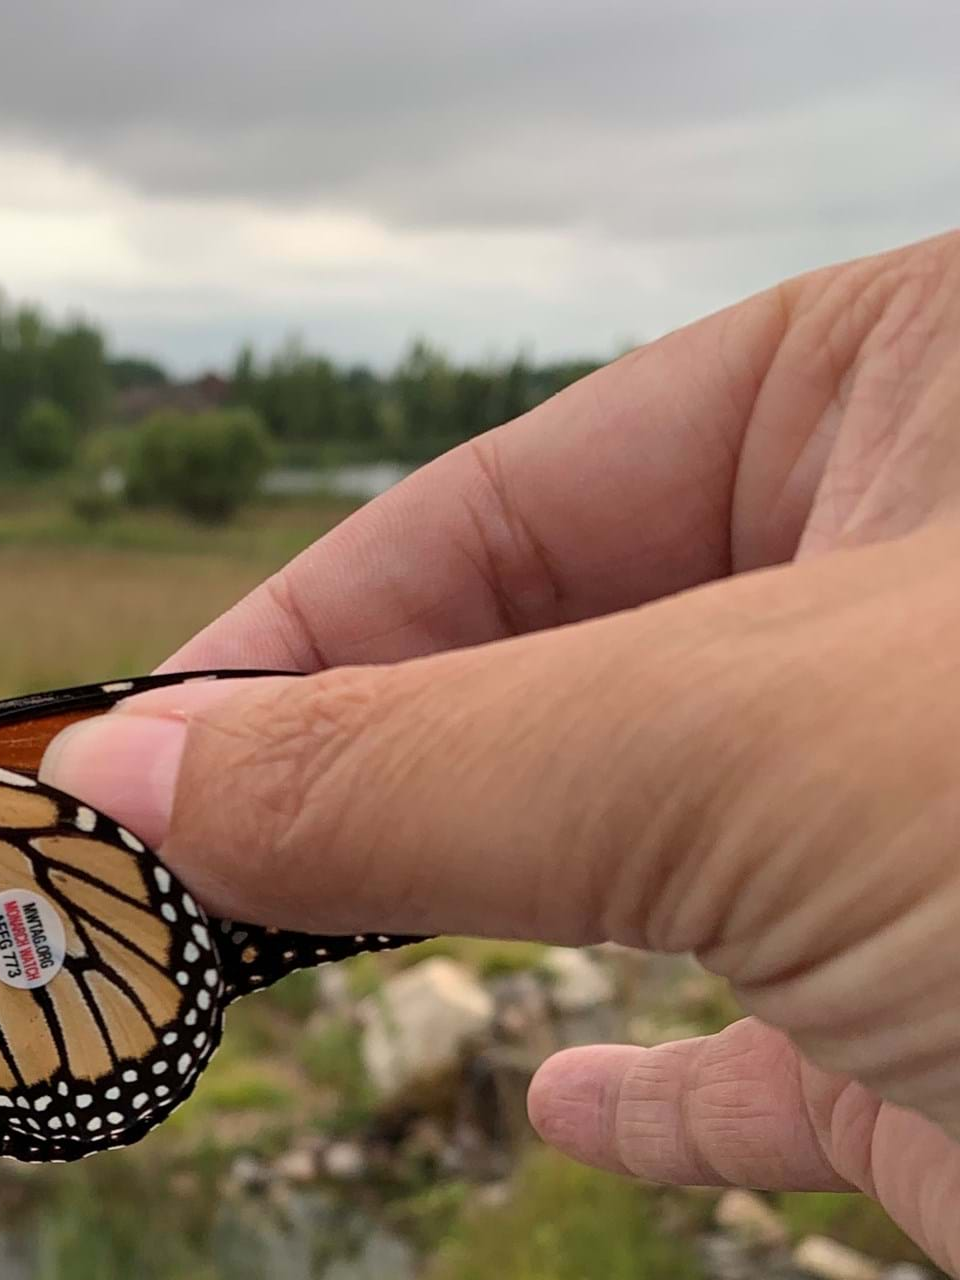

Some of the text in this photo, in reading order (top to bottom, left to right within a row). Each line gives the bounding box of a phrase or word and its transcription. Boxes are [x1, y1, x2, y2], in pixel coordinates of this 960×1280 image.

[2, 951, 22, 978] 773
[3, 900, 42, 981] MONARCH WATCH
[22, 902, 54, 969] MWTAG.ORG
